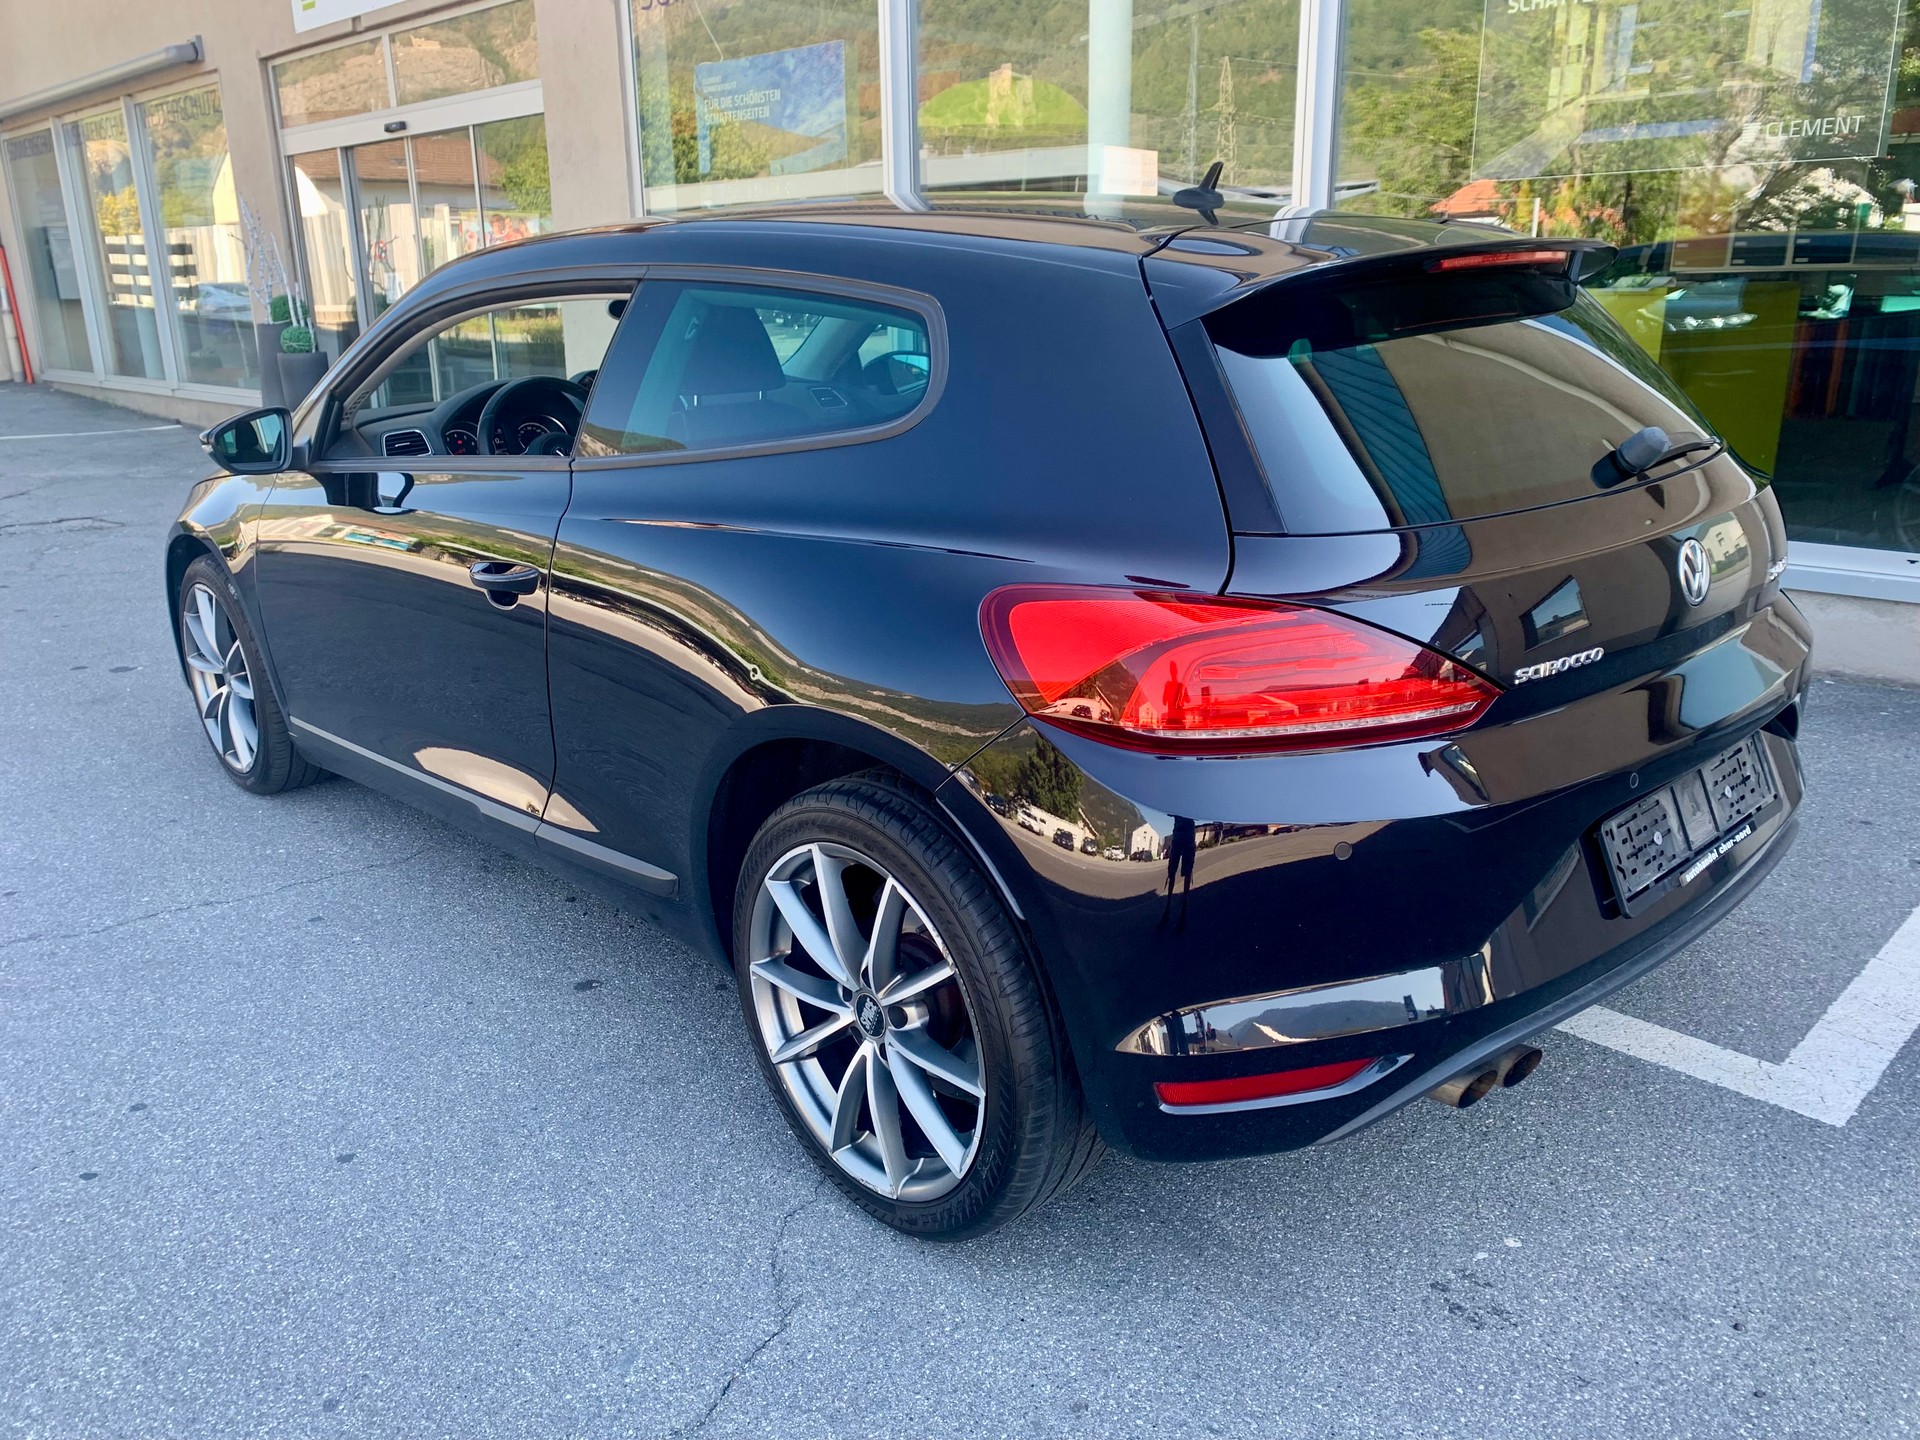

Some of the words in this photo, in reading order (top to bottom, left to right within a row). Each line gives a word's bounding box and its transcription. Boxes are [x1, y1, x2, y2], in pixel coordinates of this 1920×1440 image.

[704, 96, 719, 113] FÜR
[720, 95, 733, 108] DIE
[734, 88, 781, 107] SCHÖNSTEN
[704, 105, 770, 125] SCHATTENSEITEN
[1765, 115, 1866, 138] CLEMENT
[1514, 647, 1605, 686] SCIROCCO
[1685, 848, 1719, 882] autohandel
[1718, 824, 1752, 854] chur-nord
